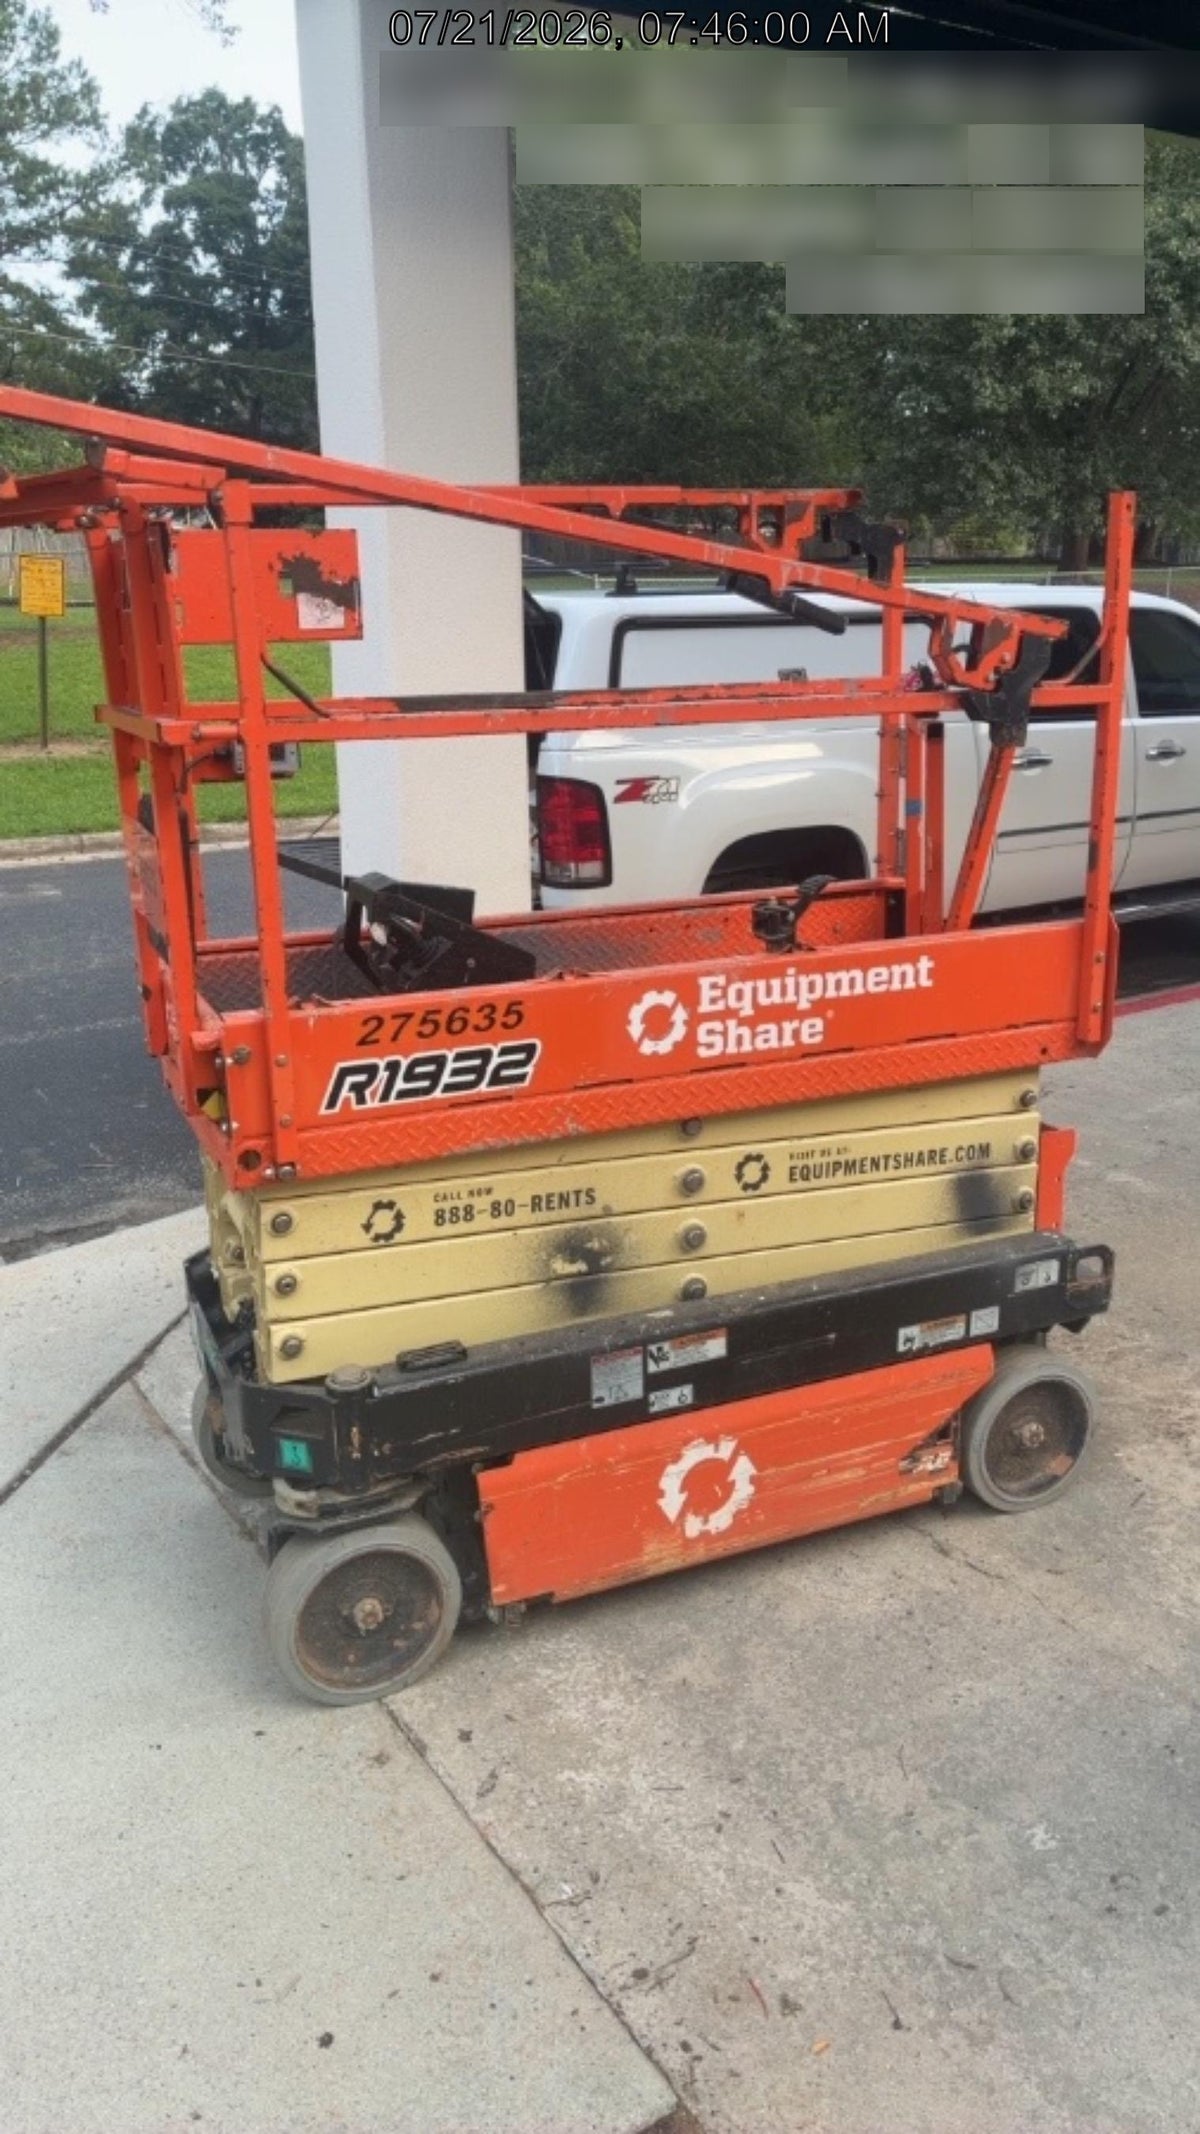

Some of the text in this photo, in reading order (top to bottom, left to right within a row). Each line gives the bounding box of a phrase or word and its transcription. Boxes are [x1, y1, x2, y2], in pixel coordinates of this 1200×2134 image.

[613, 775, 680, 804] Z71
[696, 954, 935, 1018] Equipment
[355, 1001, 525, 1046] 275635
[696, 1016, 825, 1059] Share
[318, 1038, 541, 1115] R1932
[788, 1142, 991, 1183] EQUIPMENTSHARE.COM
[433, 1191, 464, 1203] CALL
[434, 1187, 597, 1227] 888-80-RENTS
